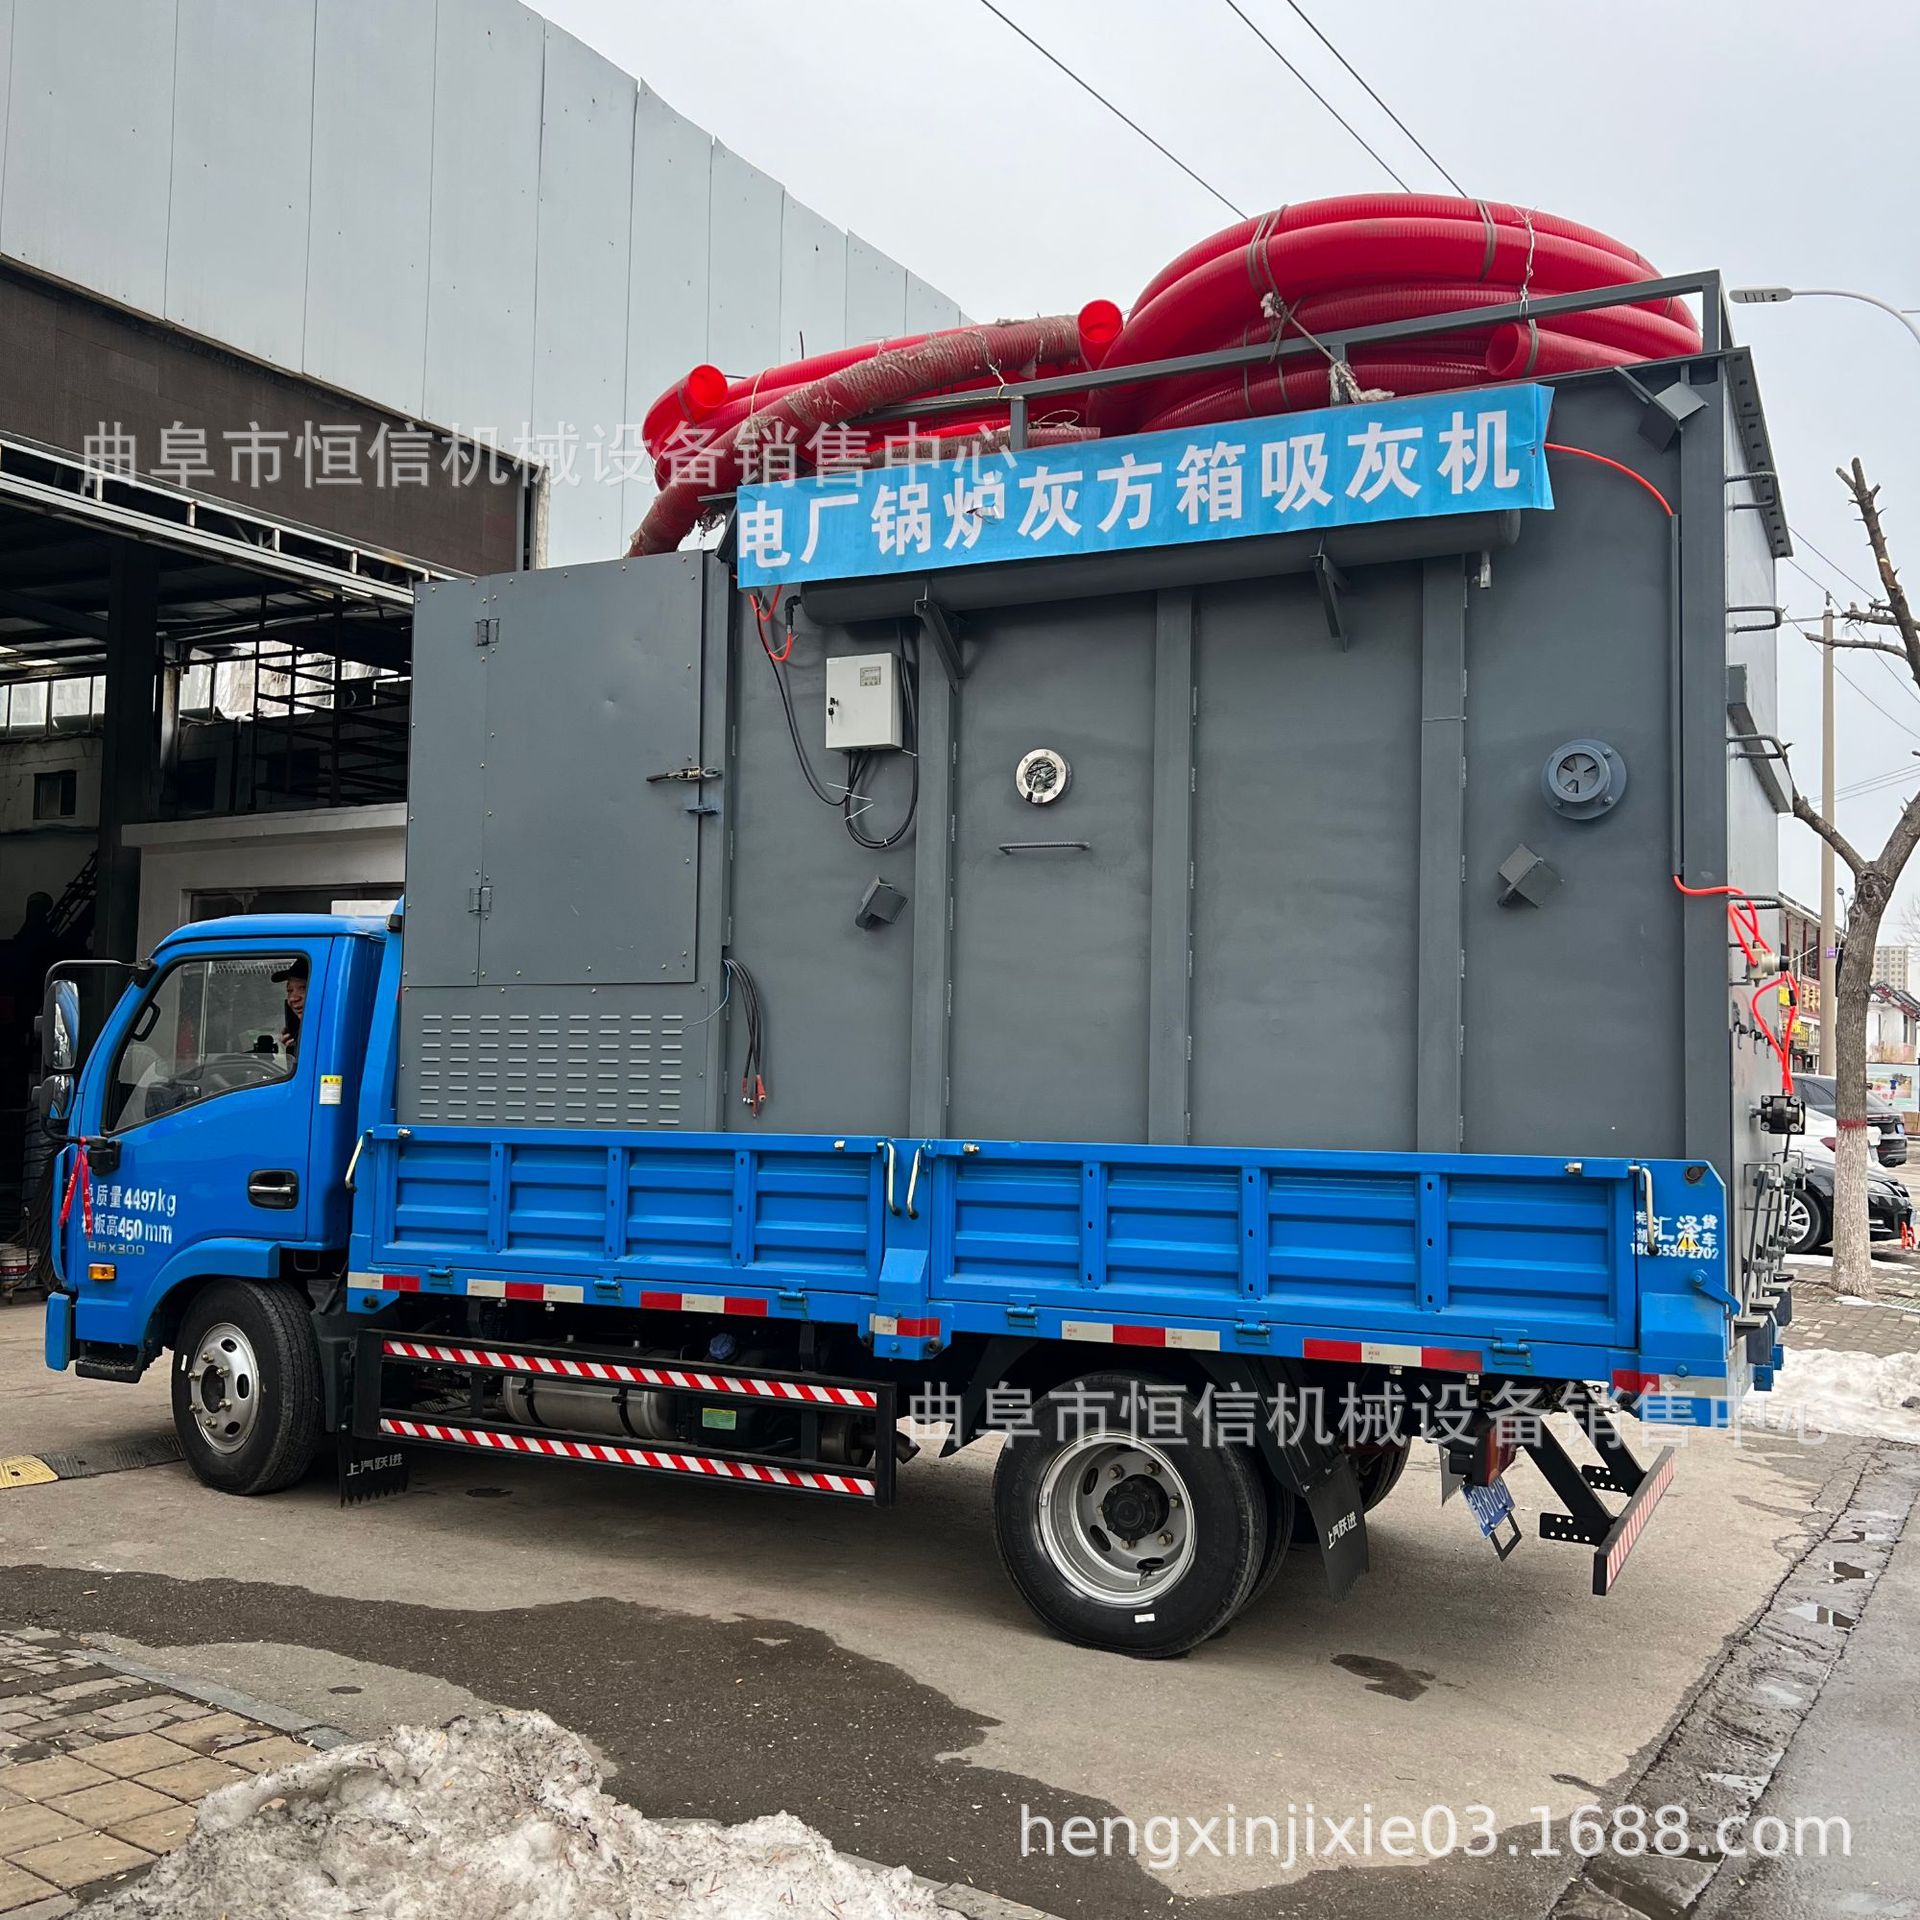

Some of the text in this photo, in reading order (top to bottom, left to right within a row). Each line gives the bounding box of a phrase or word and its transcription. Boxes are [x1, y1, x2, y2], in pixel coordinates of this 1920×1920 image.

[738, 410, 1521, 570] 电厂锅炉灰方箱吸灰机
